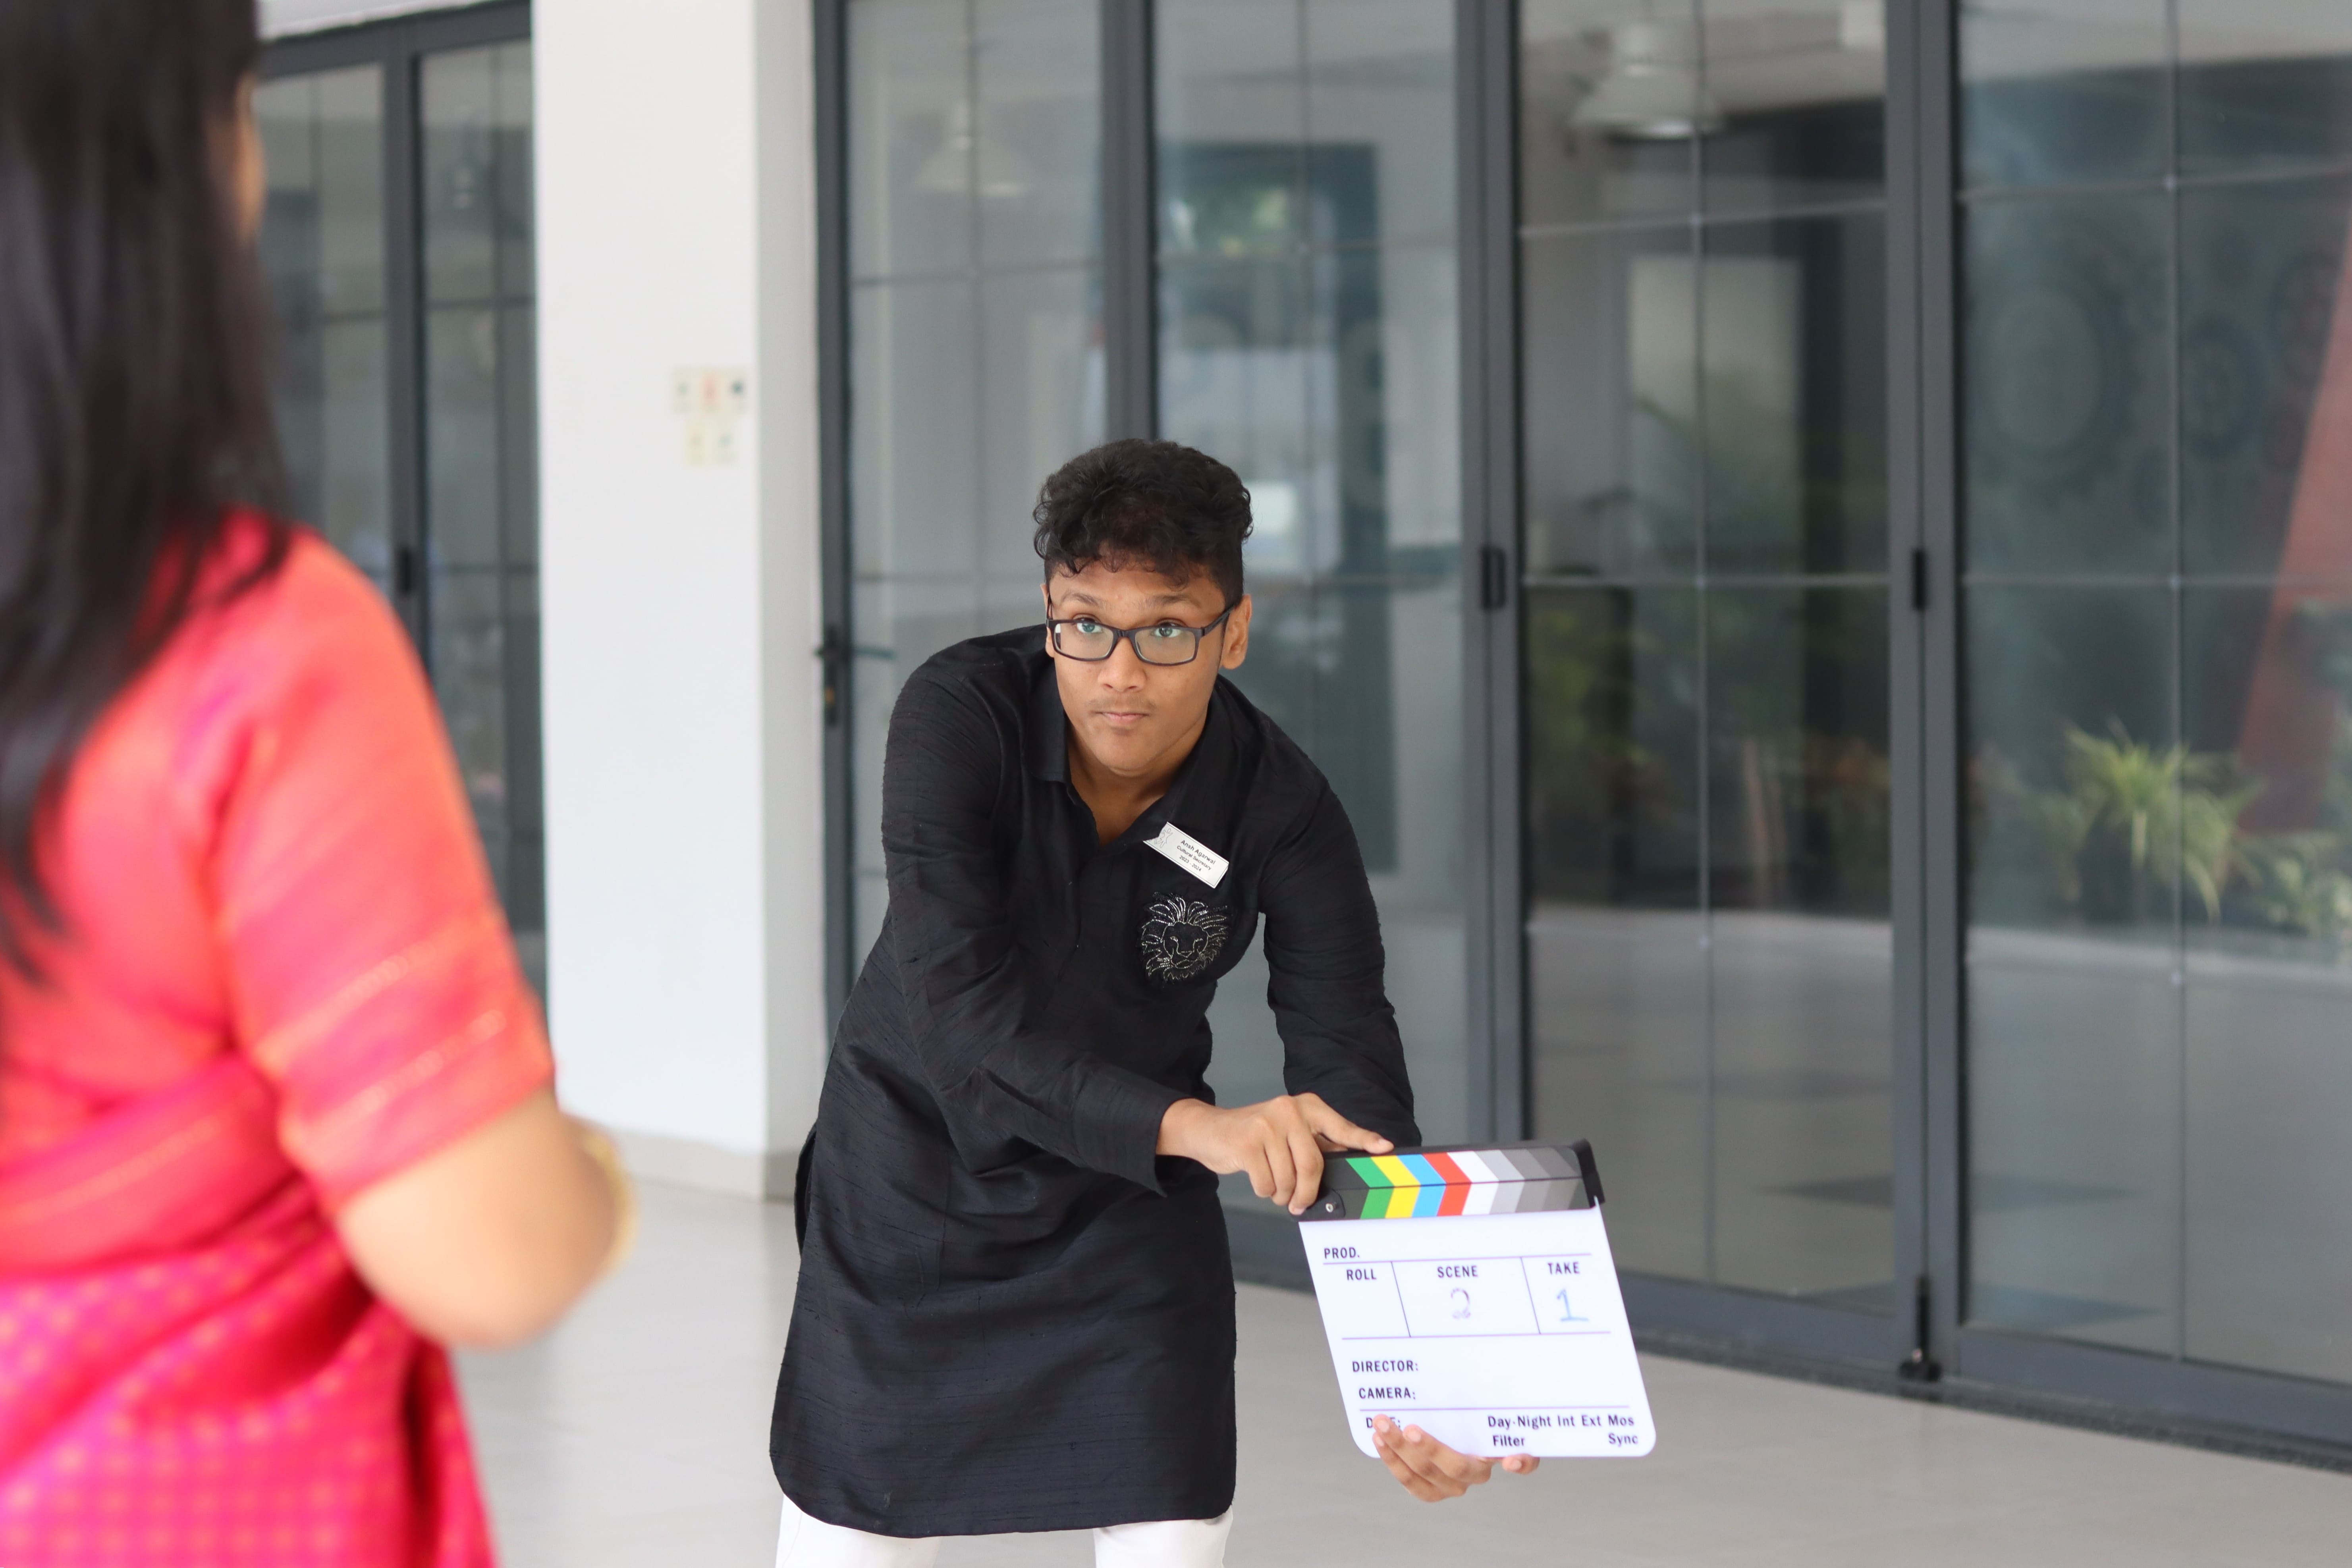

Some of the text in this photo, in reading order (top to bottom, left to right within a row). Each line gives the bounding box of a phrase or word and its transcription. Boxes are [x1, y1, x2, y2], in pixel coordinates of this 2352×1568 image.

[1177, 845, 1212, 870] Cultural Secretary
[1181, 840, 1216, 864] Ansh Agarwal
[1179, 855, 1189, 863] 2023
[1324, 1247, 1360, 1259] PROD.
[1437, 1265, 1478, 1278] SCENE
[1547, 1261, 1580, 1275] TAKE
[1346, 1269, 1377, 1281] ROLL
[1450, 1287, 1471, 1319] 2
[1557, 1289, 1589, 1322] 1
[1352, 1360, 1418, 1373] DIRECTOR:
[1358, 1387, 1416, 1400] CAMERA:
[1558, 1415, 1575, 1427] Int
[1581, 1415, 1601, 1427] Ext
[1608, 1414, 1634, 1426] Mos
[1493, 1435, 1525, 1447] Filter
[1608, 1432, 1639, 1447] Sync
